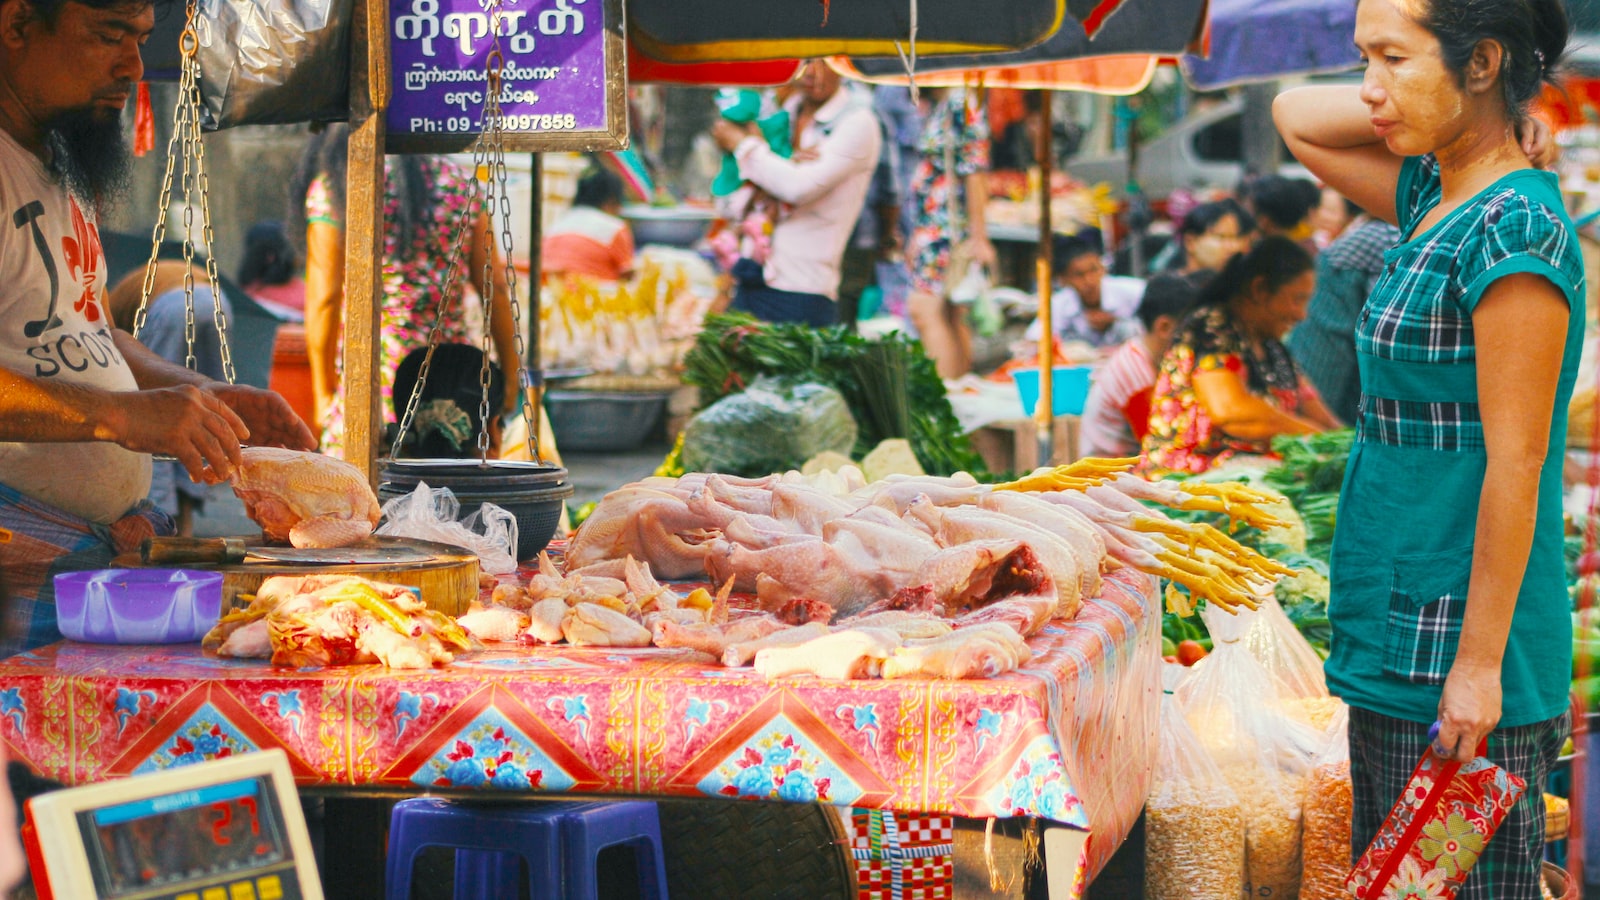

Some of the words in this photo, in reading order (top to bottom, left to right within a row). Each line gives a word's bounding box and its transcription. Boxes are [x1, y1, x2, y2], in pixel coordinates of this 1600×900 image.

[410, 118, 443, 132] Ph:
[446, 116, 471, 132] 09
[211, 795, 261, 847] 27
